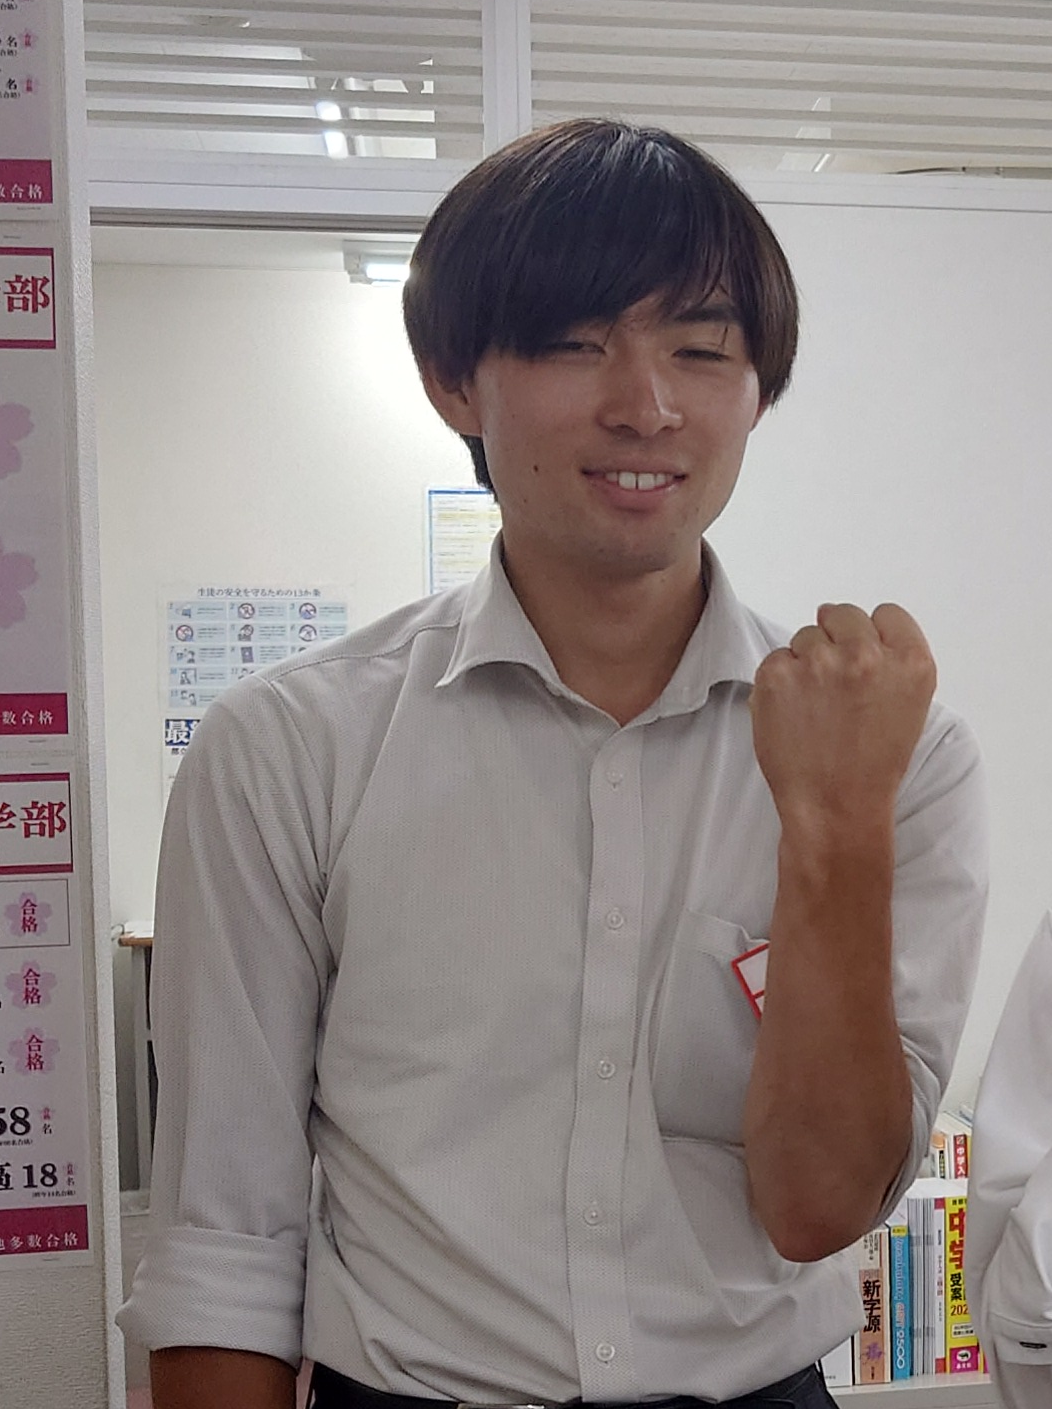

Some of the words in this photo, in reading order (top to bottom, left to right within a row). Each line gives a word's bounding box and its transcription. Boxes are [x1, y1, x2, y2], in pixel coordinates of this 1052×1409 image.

[3, 274, 50, 314] 部
[167, 721, 199, 744] 最
[21, 898, 38, 934] 合格
[23, 967, 41, 1005] 合格
[26, 1034, 44, 1072] 合格
[23, 1163, 57, 1189] 18
[956, 1147, 966, 1179] 中学入
[863, 1279, 881, 1333] 新字源
